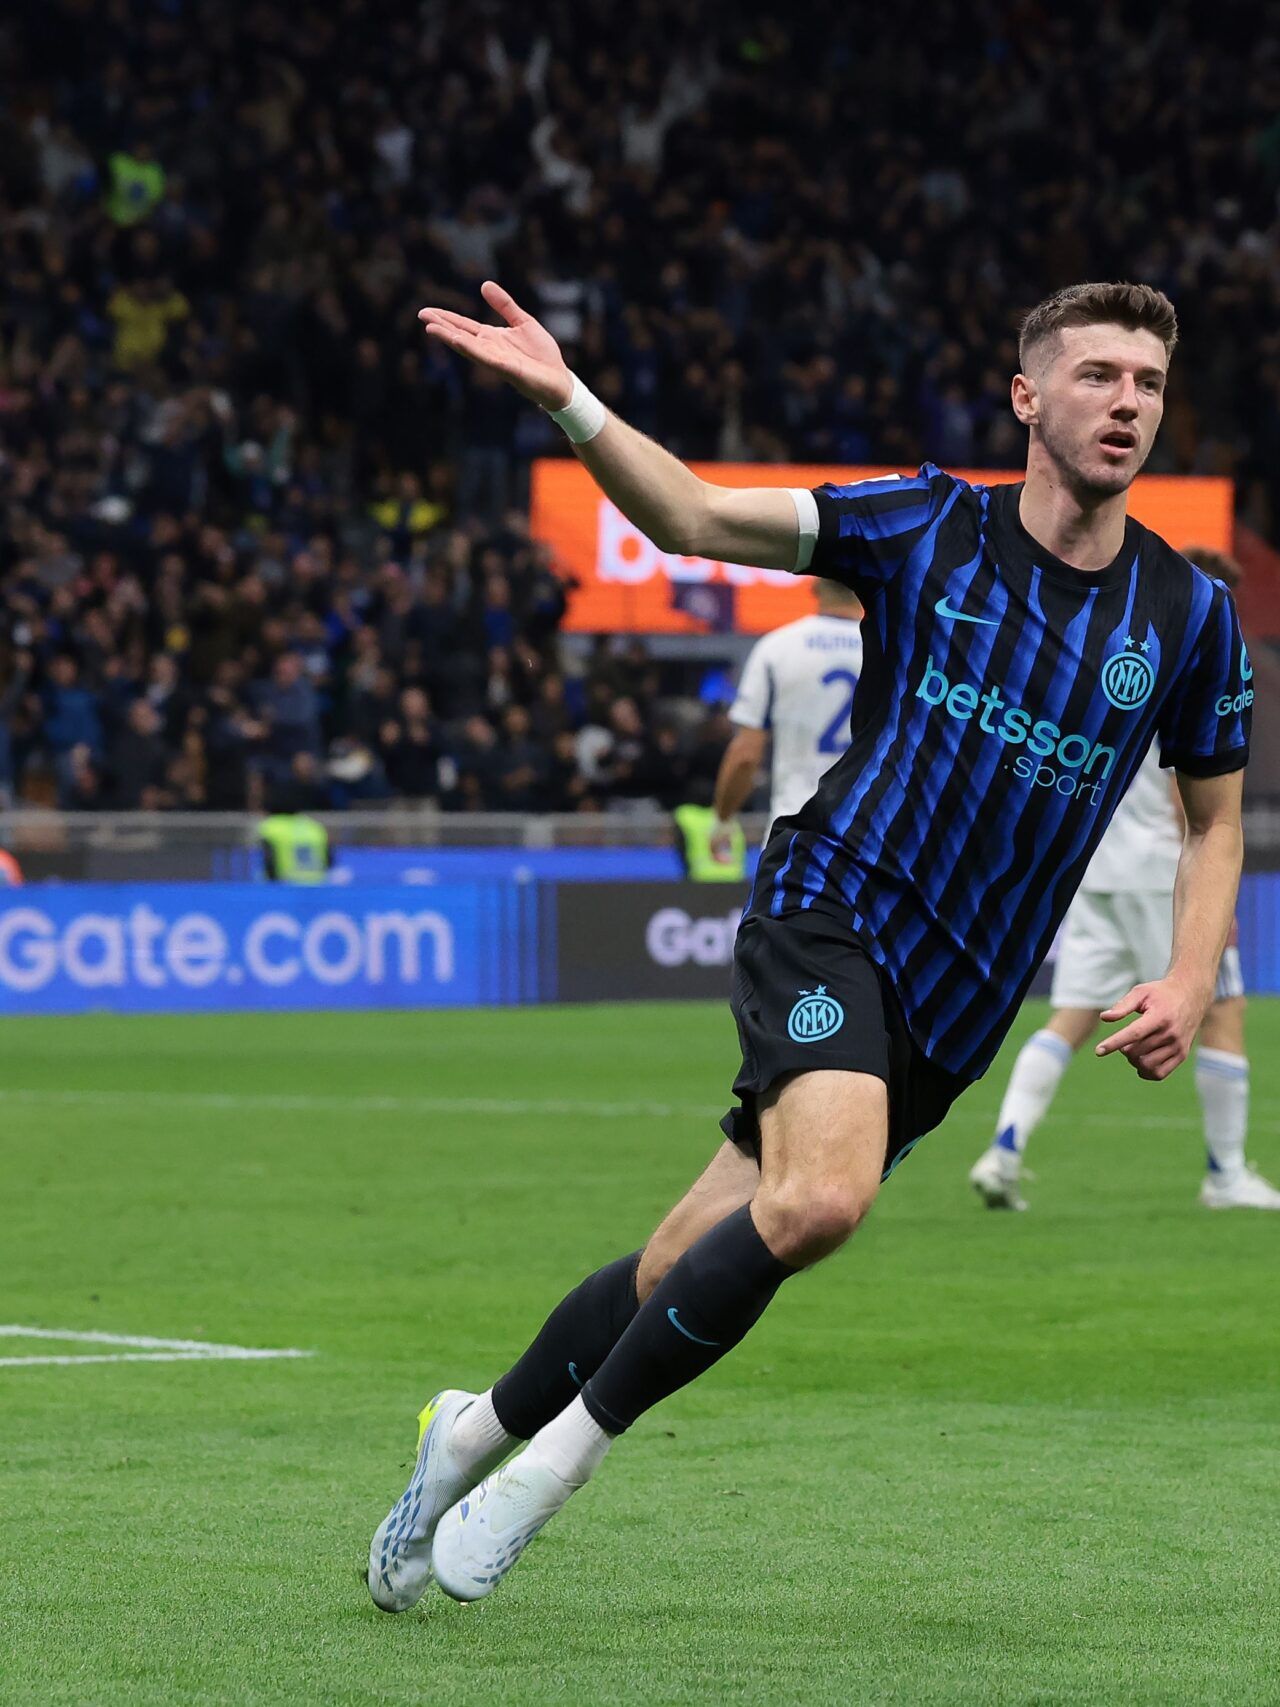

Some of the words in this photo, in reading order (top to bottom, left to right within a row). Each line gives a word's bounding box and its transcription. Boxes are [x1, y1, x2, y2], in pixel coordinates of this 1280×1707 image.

[914, 654, 1117, 780] betsson
[1214, 688, 1255, 717] Gate
[0, 903, 454, 992] Gate.com
